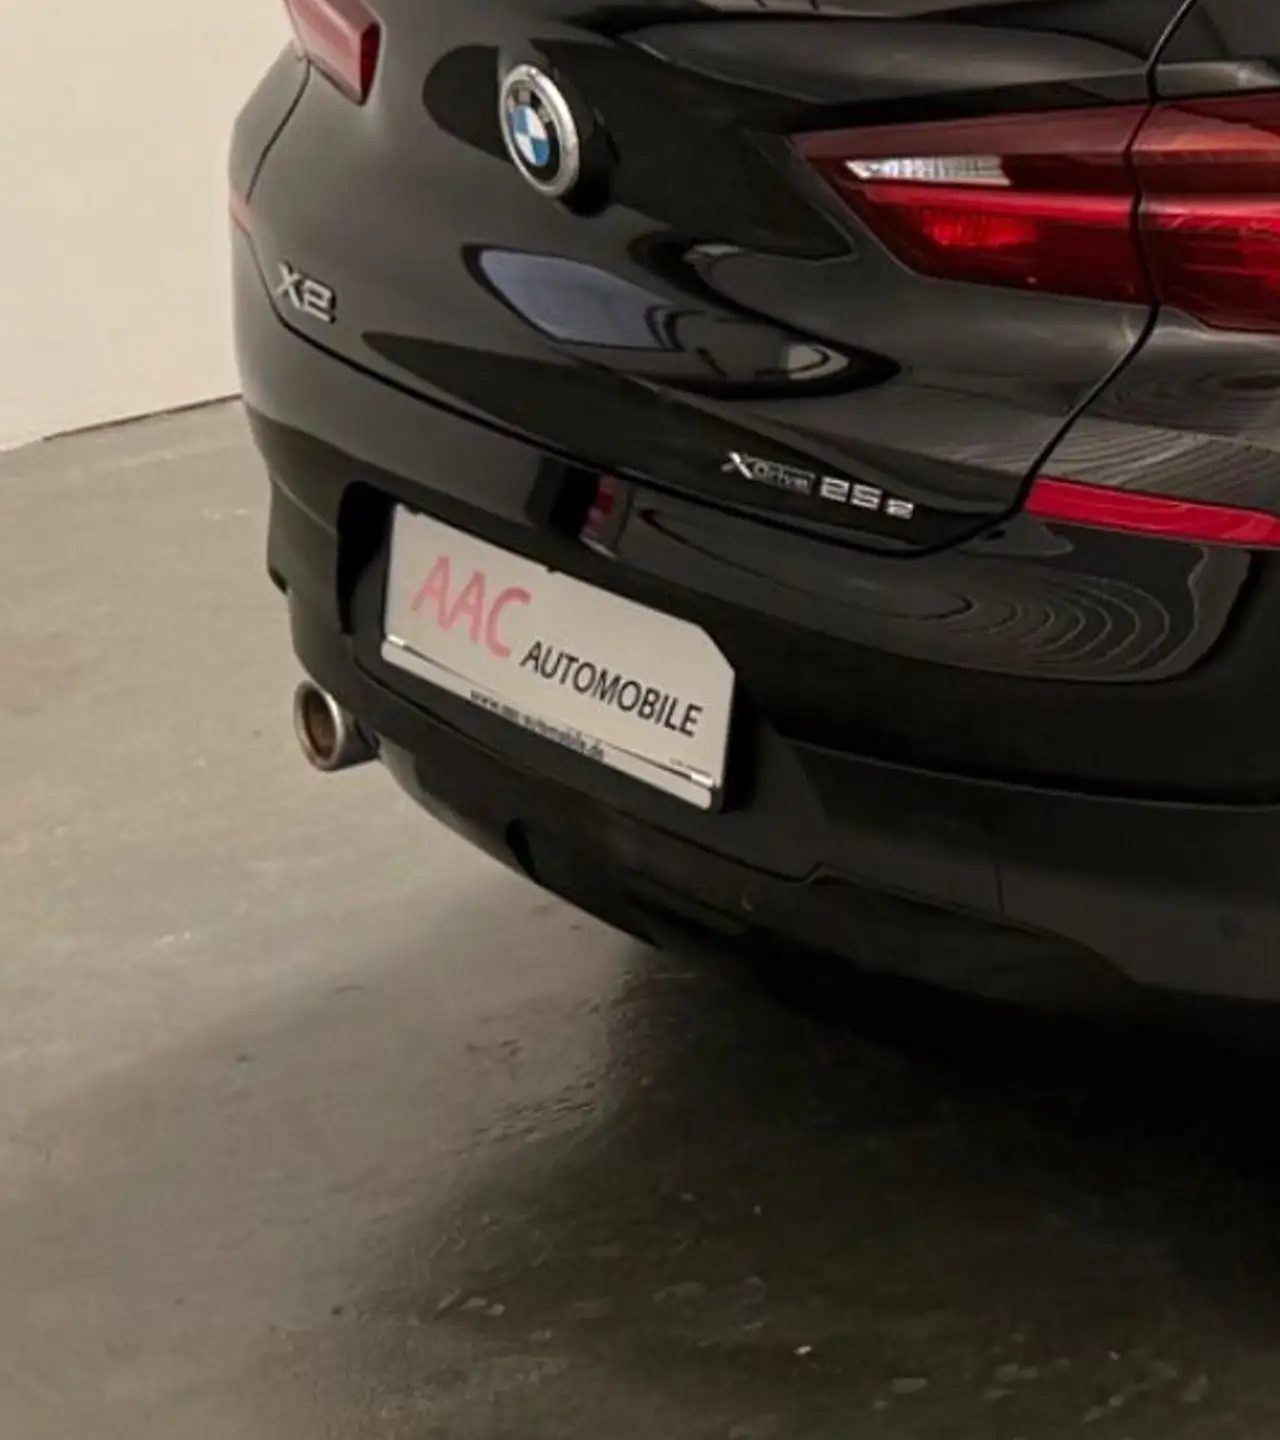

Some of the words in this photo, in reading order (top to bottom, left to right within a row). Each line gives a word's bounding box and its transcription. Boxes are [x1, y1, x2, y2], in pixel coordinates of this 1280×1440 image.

[274, 259, 337, 324] X2
[409, 555, 532, 659] AAC
[519, 640, 704, 738] AUTOMOBILE
